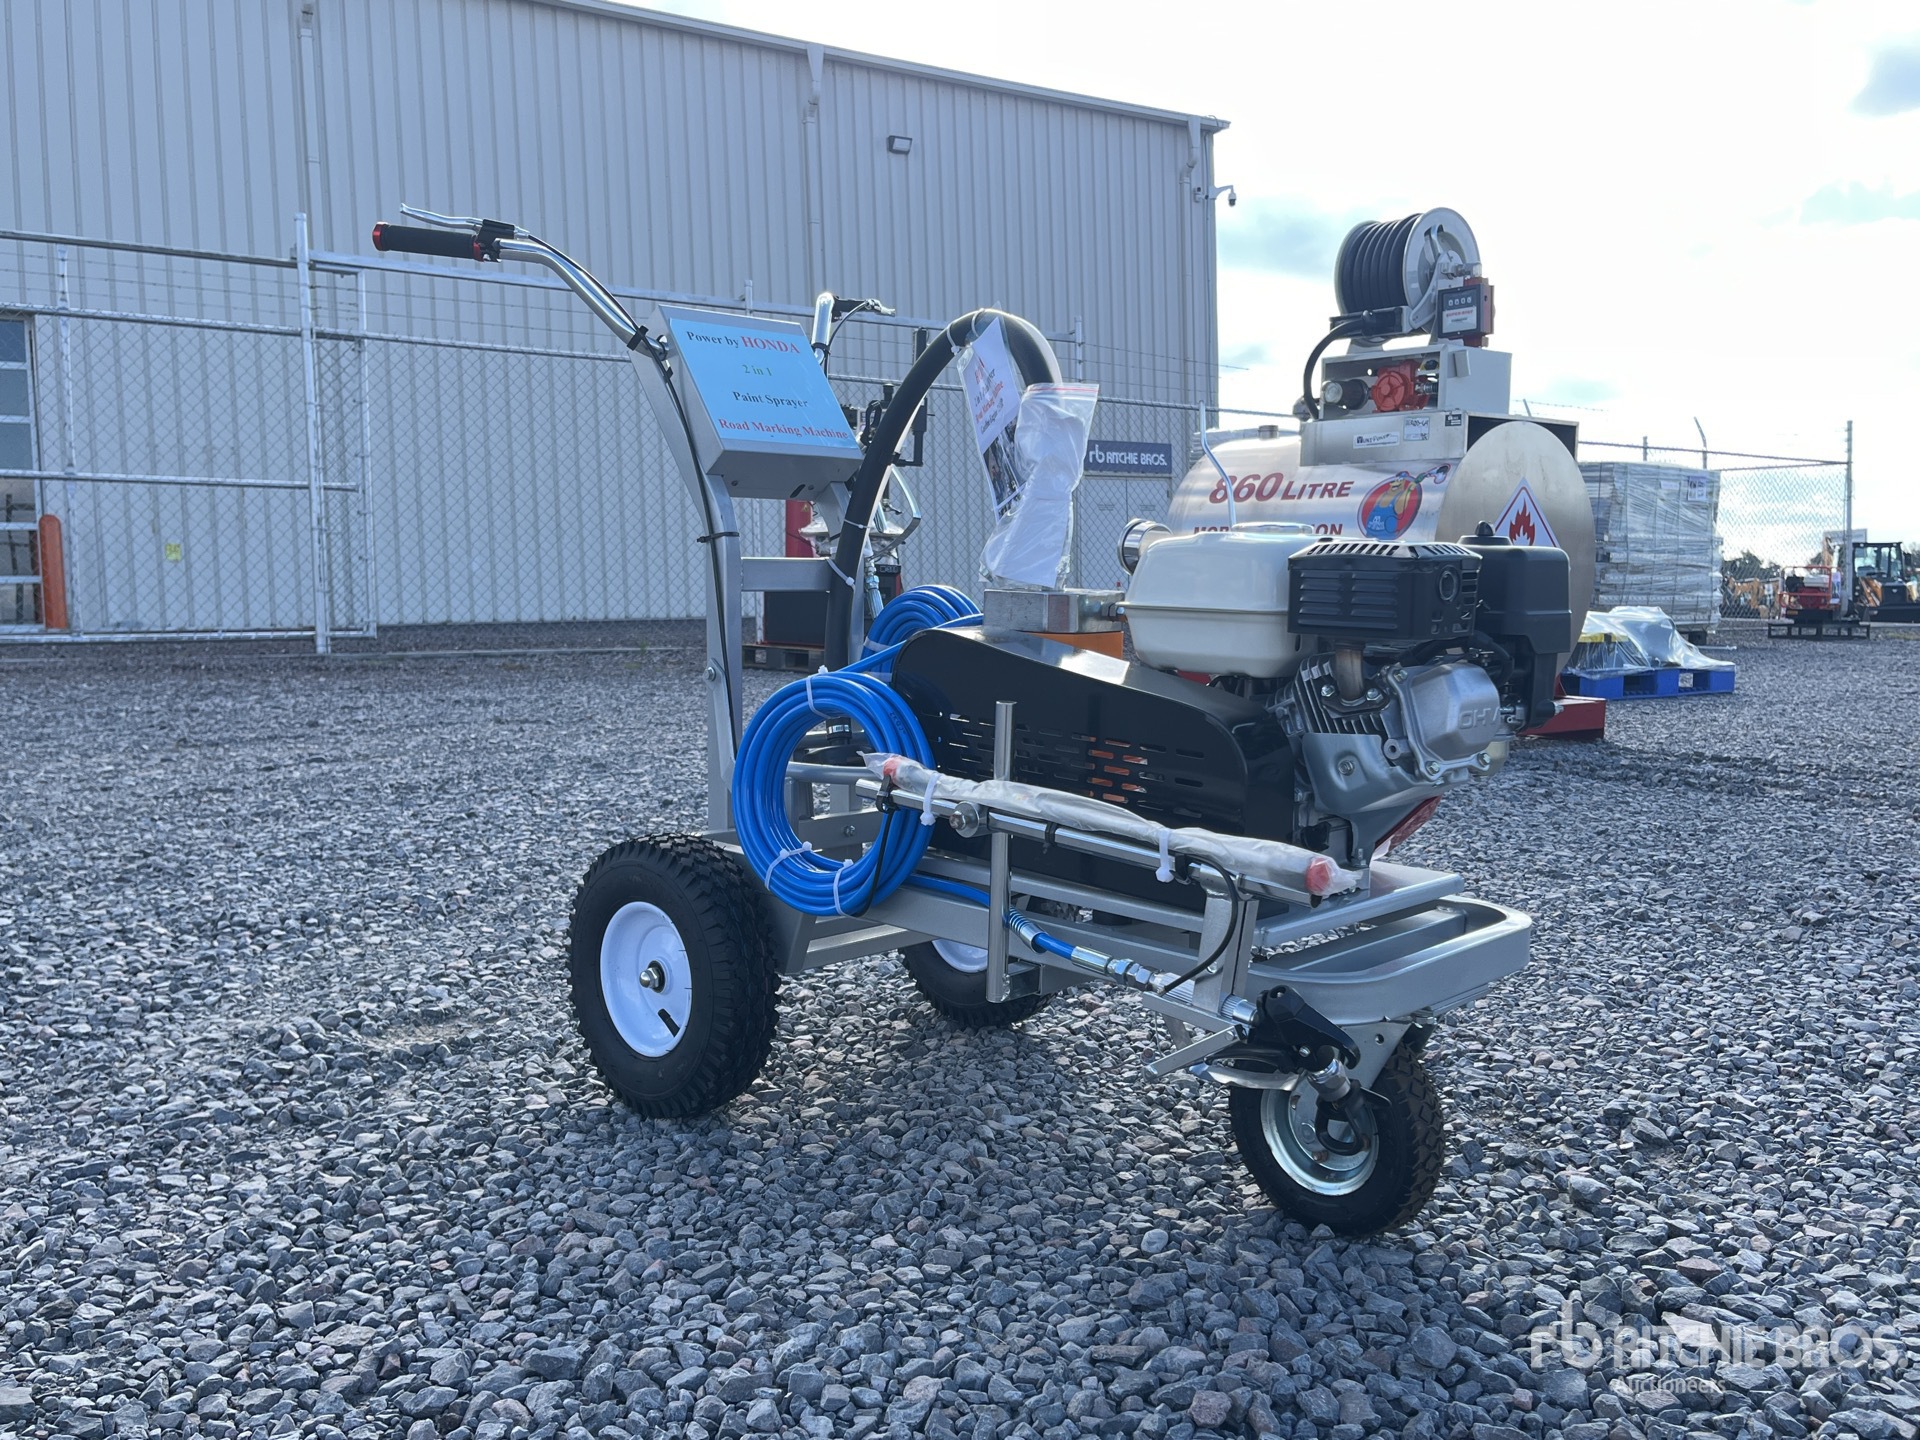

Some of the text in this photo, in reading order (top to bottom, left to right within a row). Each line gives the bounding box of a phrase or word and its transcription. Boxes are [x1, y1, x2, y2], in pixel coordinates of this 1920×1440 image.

[686, 331, 801, 354] Power by HONDA
[742, 364, 752, 374] 2
[752, 365, 765, 376] in
[732, 391, 808, 409] Paint Sprayer
[718, 418, 849, 440] Road Marking Machine
[1089, 444, 1168, 466] rb RITCHIE BROS.
[1208, 472, 1355, 504] 860 LITRE
[1459, 706, 1501, 730] OHV
